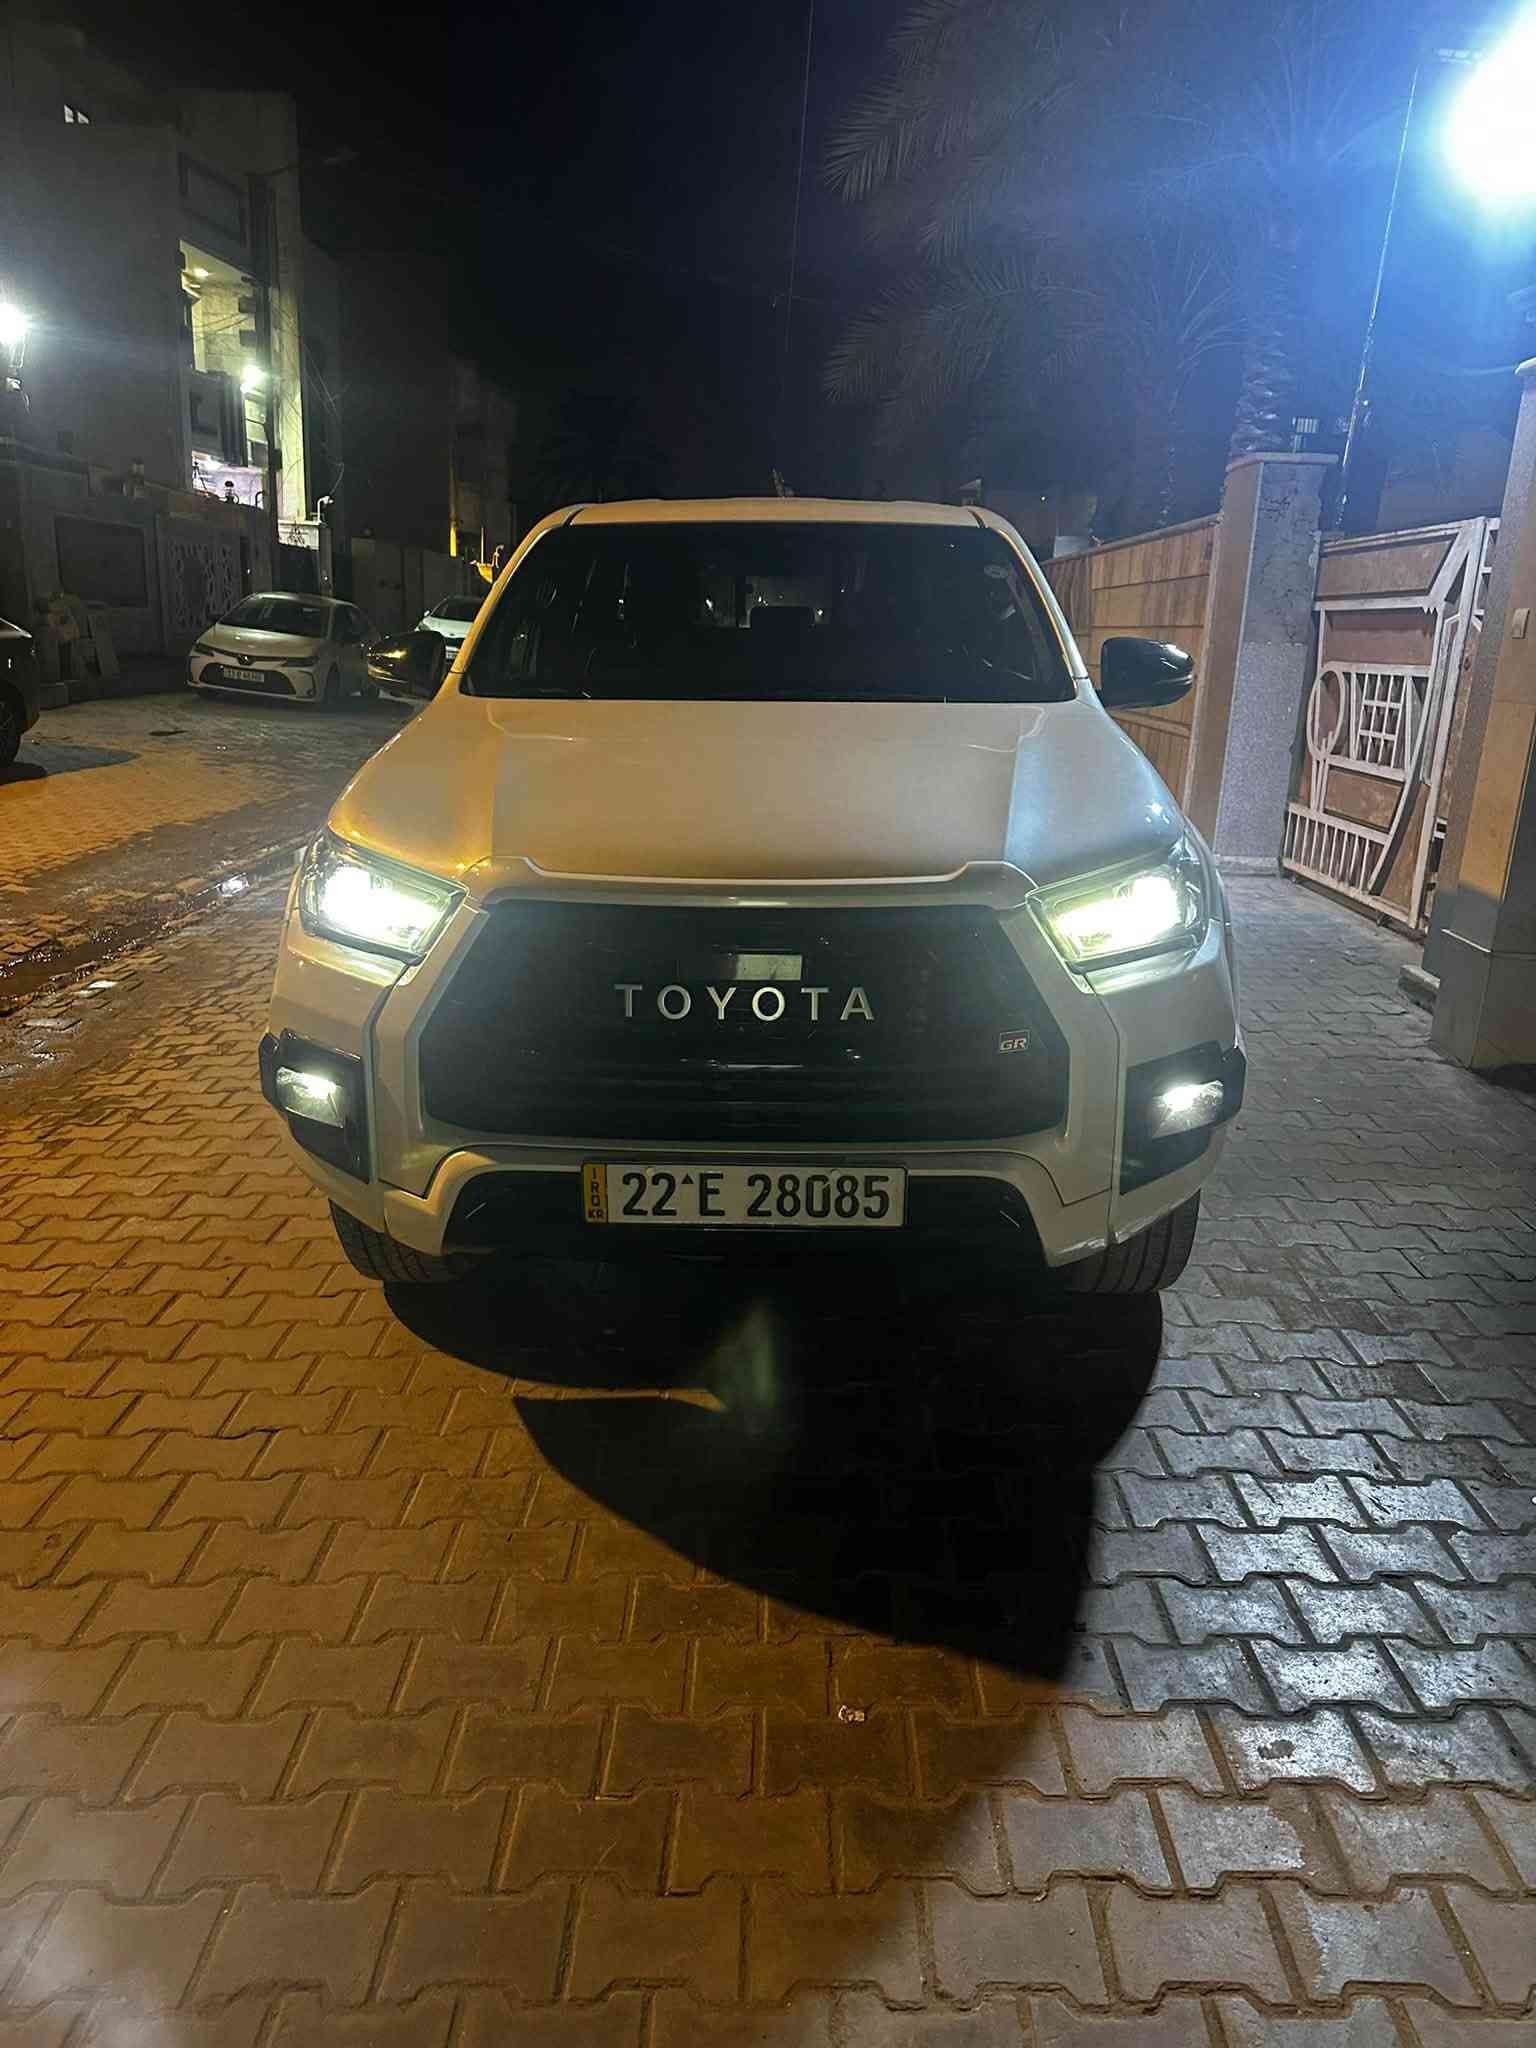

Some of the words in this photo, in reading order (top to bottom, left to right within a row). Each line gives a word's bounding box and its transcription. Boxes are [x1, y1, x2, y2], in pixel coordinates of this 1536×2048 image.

[613, 983, 875, 1022] TOYOTA
[1000, 1038, 1027, 1051] GR
[621, 1172, 677, 1217] 22
[699, 1172, 725, 1218] E
[747, 1173, 890, 1219] 28085
